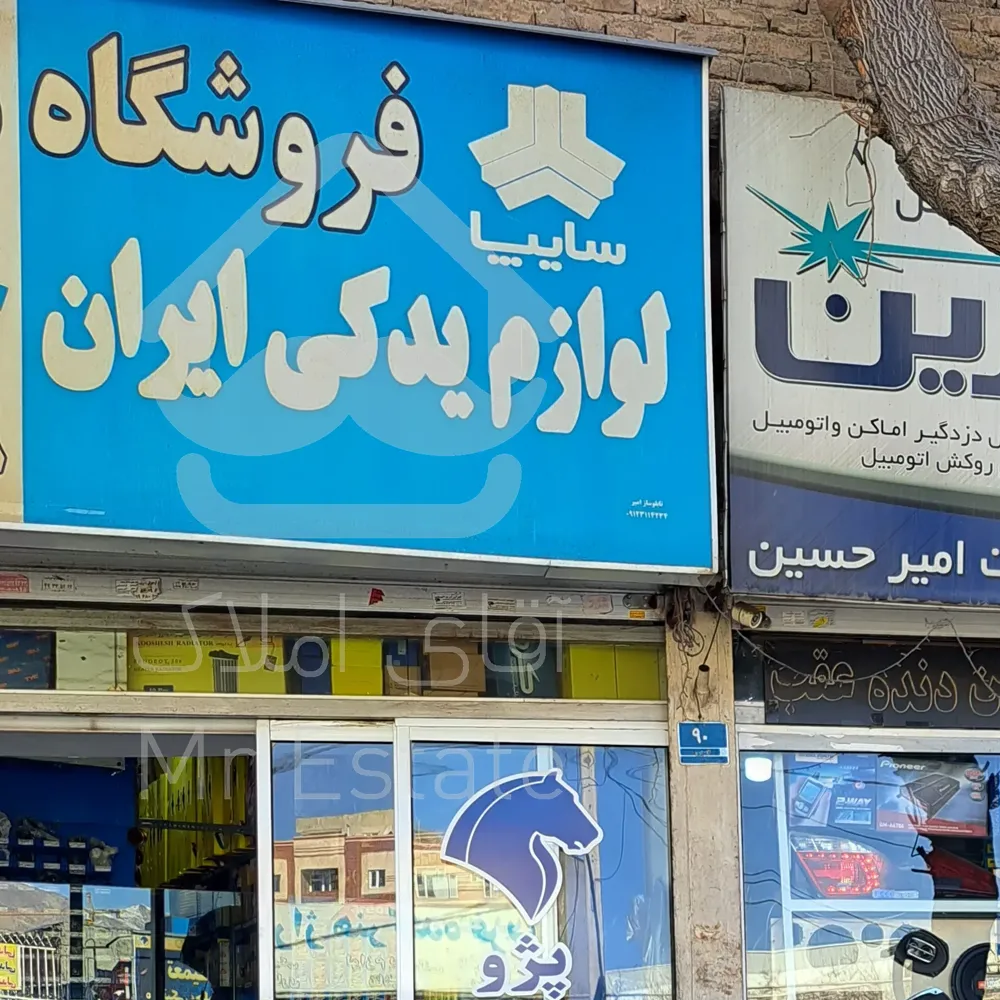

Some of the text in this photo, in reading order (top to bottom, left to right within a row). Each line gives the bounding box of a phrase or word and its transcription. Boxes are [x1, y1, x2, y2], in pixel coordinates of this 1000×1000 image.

[29, 32, 424, 234] فروشگاه
[469, 211, 626, 271] سایپا
[42, 237, 671, 438] لوازم یدکی ایران
[848, 418, 906, 439] اماکن
[914, 421, 982, 446] دزدگیر
[861, 447, 929, 469] اتومبیل
[936, 453, 993, 476] روکش
[748, 540, 875, 580] حسین
[888, 541, 964, 586] امیر
[771, 647, 855, 715] عقب
[867, 657, 957, 714] دنده
[691, 727, 708, 744] ۹۰
[880, 759, 926, 771] Pioneer
[475, 932, 570, 1000] پژو
